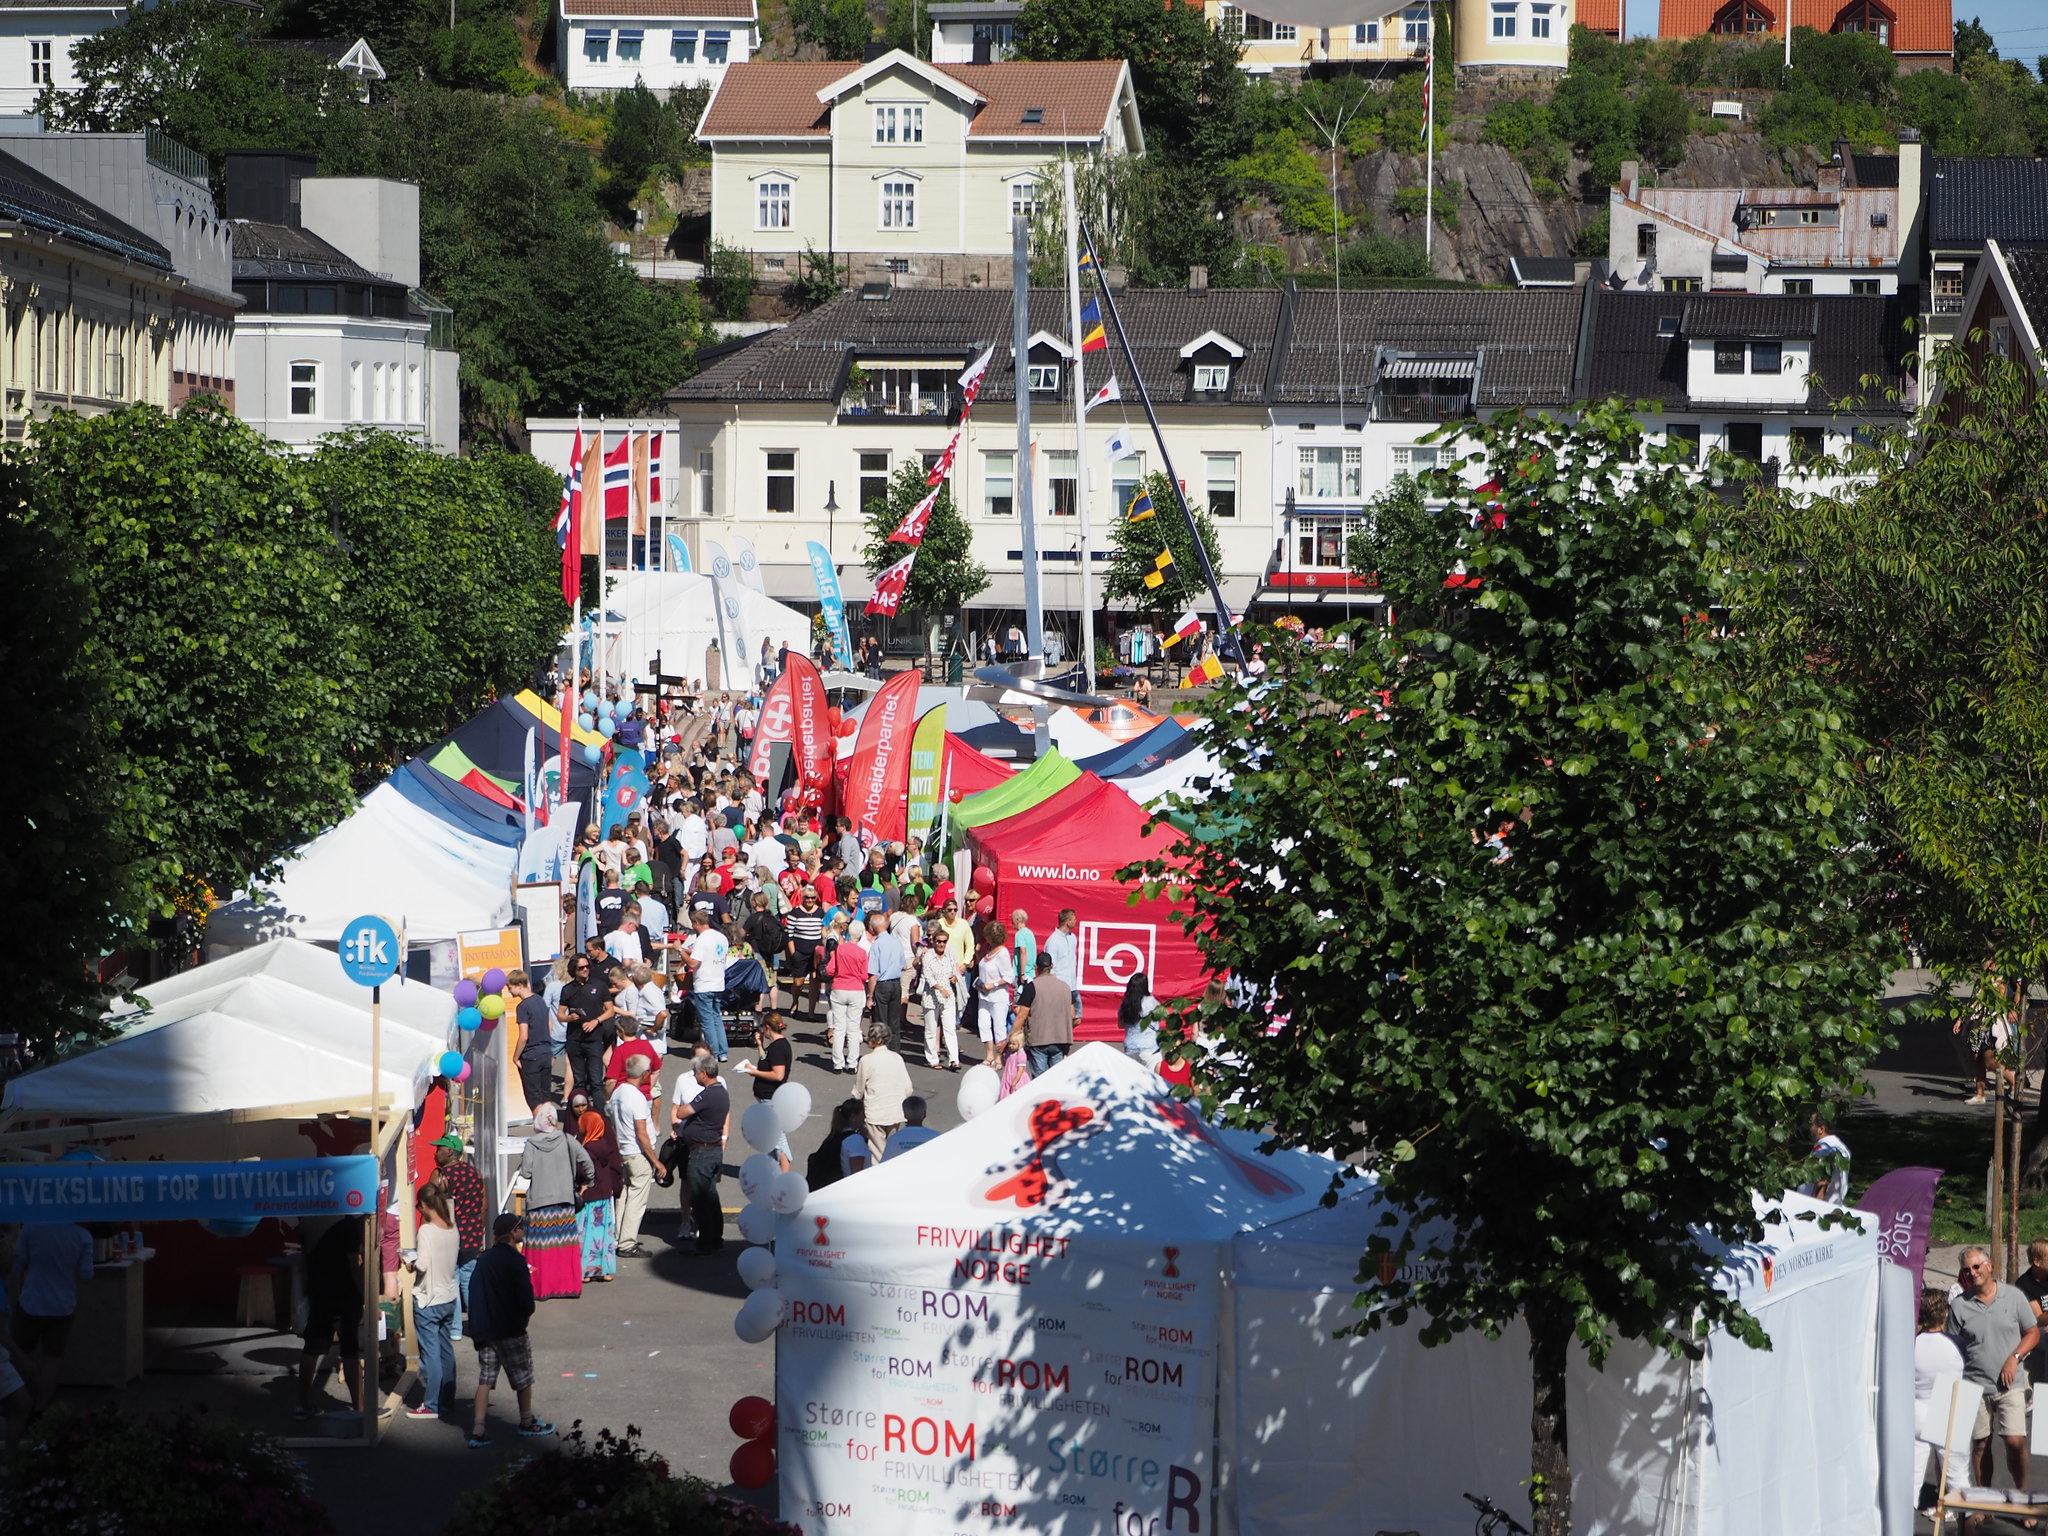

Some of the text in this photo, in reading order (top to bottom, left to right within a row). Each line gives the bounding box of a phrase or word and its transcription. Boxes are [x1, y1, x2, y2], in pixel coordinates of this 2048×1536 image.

[862, 693, 900, 826] Arbeiderpartiet
[1018, 864, 1100, 881] www.lo.no
[465, 949, 518, 963] INVITASJON
[0, 1174, 144, 1206] TVEKSLING
[158, 1174, 199, 1202] FOR
[917, 1226, 1071, 1259] FRIVILLIGHET
[1891, 1211, 1914, 1258] 2015
[796, 1248, 846, 1259] FRIVILLIGHET
[808, 1259, 833, 1269] NORGE
[1773, 1243, 1834, 1282] DEN NORSKE KIRKE
[954, 1258, 1031, 1285] NORGE
[869, 1281, 918, 1300] Større
[1144, 1279, 1196, 1293] FRIVILLIGHET
[1157, 1291, 1183, 1301] NORGE
[793, 1301, 845, 1326] ROM
[897, 1290, 988, 1322] for ROM
[793, 1327, 876, 1343] FRIVILLIGHETEN
[1038, 1318, 1066, 1331] ROM
[1159, 1327, 1193, 1344] ROM
[872, 1357, 932, 1380] for ROM
[942, 1349, 994, 1370] Større
[972, 1359, 1070, 1394] for ROM
[1104, 1356, 1182, 1387] for ROM
[806, 1401, 877, 1428] Større
[1000, 1394, 1111, 1417] FRIVILLIGHETEN
[801, 1430, 828, 1441] ROM
[847, 1413, 975, 1462] for ROM
[1138, 1422, 1161, 1434] ROM
[1048, 1436, 1160, 1487] Større
[885, 1460, 1034, 1492] FRIVILLIGHETEN
[898, 1488, 929, 1504] ROM
[1062, 1494, 1086, 1505] ROM
[816, 1501, 851, 1517] ROM
[982, 1501, 1017, 1517] ROM
[1113, 1501, 1159, 1536] for
